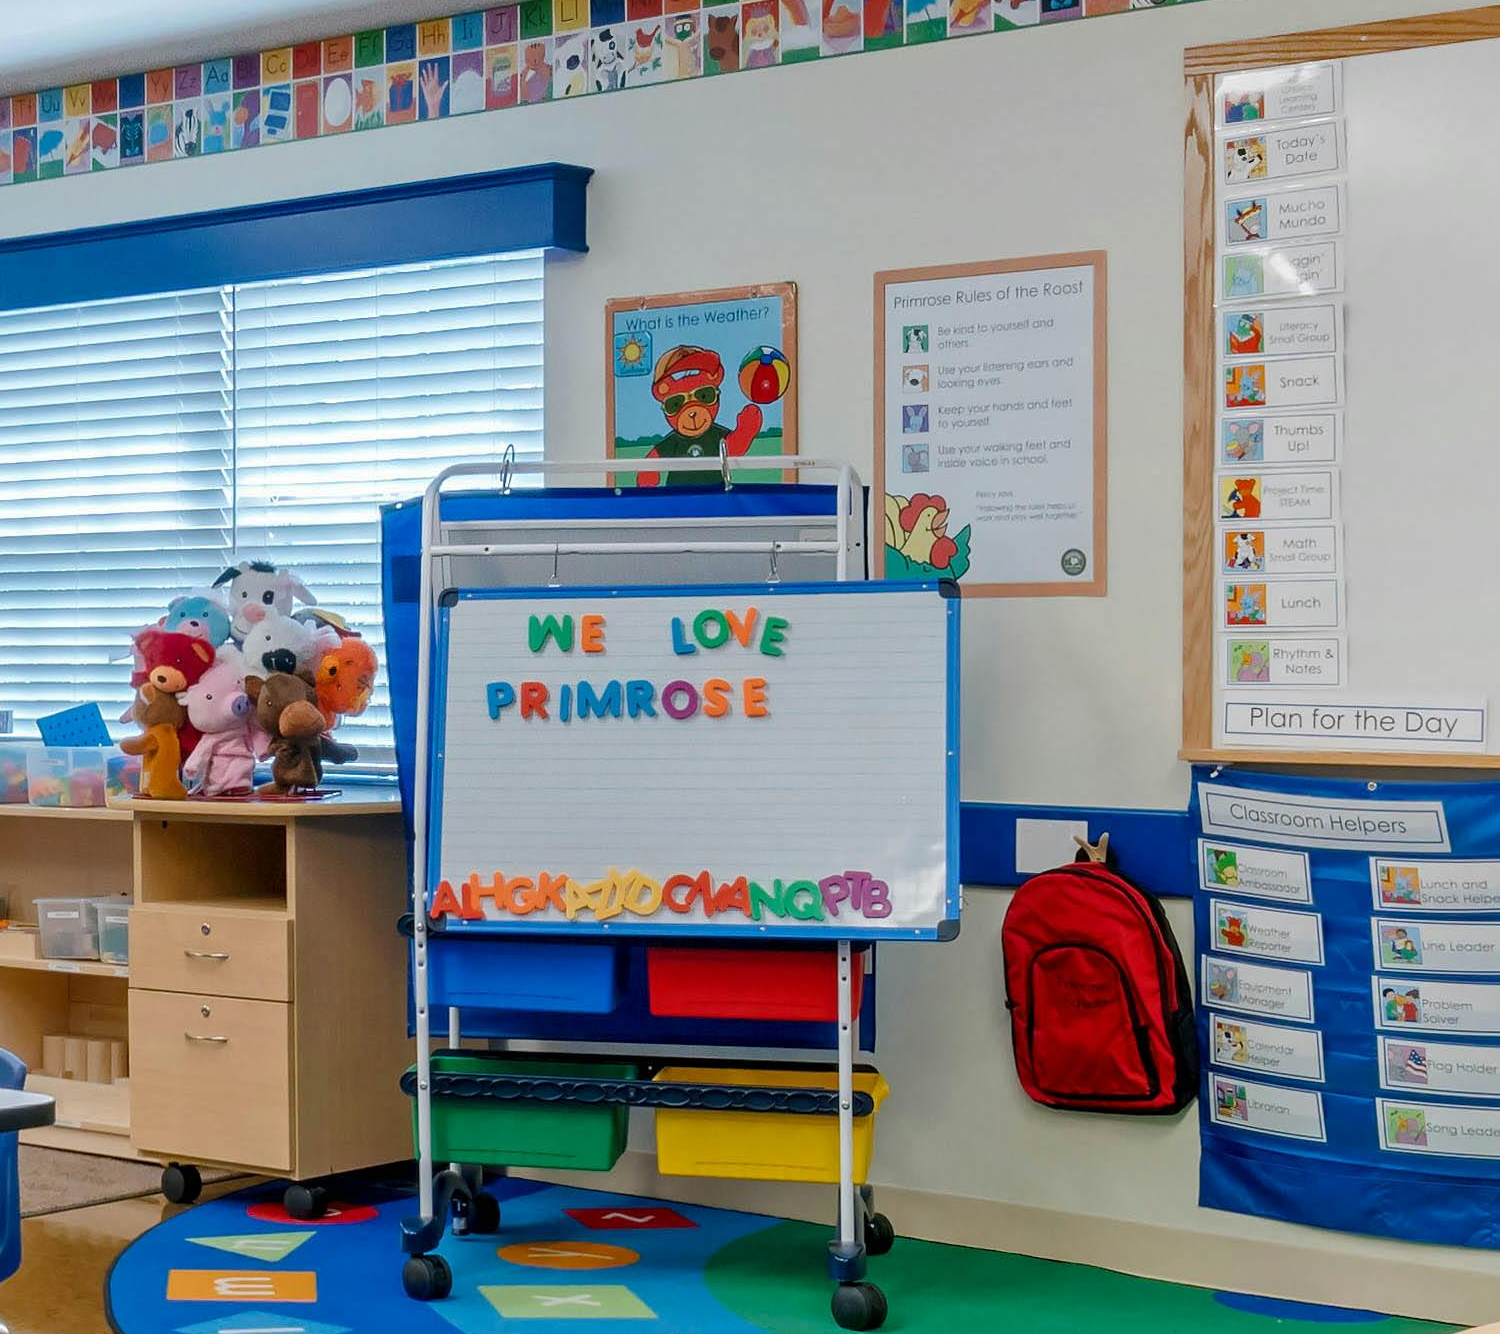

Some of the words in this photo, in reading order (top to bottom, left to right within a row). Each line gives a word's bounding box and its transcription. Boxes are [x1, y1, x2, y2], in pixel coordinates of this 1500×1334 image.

[1277, 133, 1327, 150] Today's
[1285, 153, 1318, 165] Date
[1279, 199, 1325, 214] Mucho
[1279, 214, 1326, 229] Mundo
[893, 293, 951, 309] Primrose
[956, 291, 992, 304] Rules
[996, 286, 1011, 301] of
[1015, 284, 1038, 298] the
[1043, 280, 1084, 297] Roost
[626, 319, 661, 331] What
[665, 316, 673, 328] is
[678, 314, 699, 326] the
[705, 307, 769, 324] Weather?
[1280, 322, 1318, 333] Literacy
[1269, 335, 1295, 345] Small
[1298, 333, 1330, 344] Group
[1280, 376, 1319, 388] Snack
[1274, 425, 1324, 435] Thumbs
[1288, 442, 1310, 452] Up!
[1282, 539, 1316, 549] Math
[1269, 553, 1295, 562] Small
[1298, 552, 1331, 563] Group
[1281, 598, 1321, 609] Lunch
[528, 614, 606, 653] WE
[671, 607, 790, 656] LOVE
[1273, 649, 1320, 660] Rhythm
[1325, 649, 1334, 659] &
[1286, 664, 1322, 674] Notes
[487, 677, 770, 722] PRIMROSE
[1250, 707, 1302, 728] Plan
[1313, 709, 1343, 730] for
[1356, 710, 1395, 731] the
[1405, 712, 1458, 738] Day
[1229, 803, 1324, 830] Classroom
[1330, 815, 1407, 837] Helpers
[1421, 879, 1457, 891] Lunch
[1461, 880, 1487, 890] and
[1422, 893, 1458, 905] Snack
[1249, 924, 1290, 939] Weather
[1247, 939, 1292, 955] Reporter
[1423, 941, 1445, 951] Line
[1449, 941, 1495, 953] Leader
[1239, 980, 1292, 998] Equipment
[1239, 995, 1285, 1011] Manager
[1422, 999, 1472, 1011] Problem
[1423, 1013, 1459, 1026] Solver
[1248, 1038, 1294, 1055] Calendar
[1248, 1053, 1280, 1069] Helper
[1457, 1062, 1498, 1075] Holder
[1248, 1100, 1290, 1115] Librarian
[1426, 1122, 1458, 1137] Song
